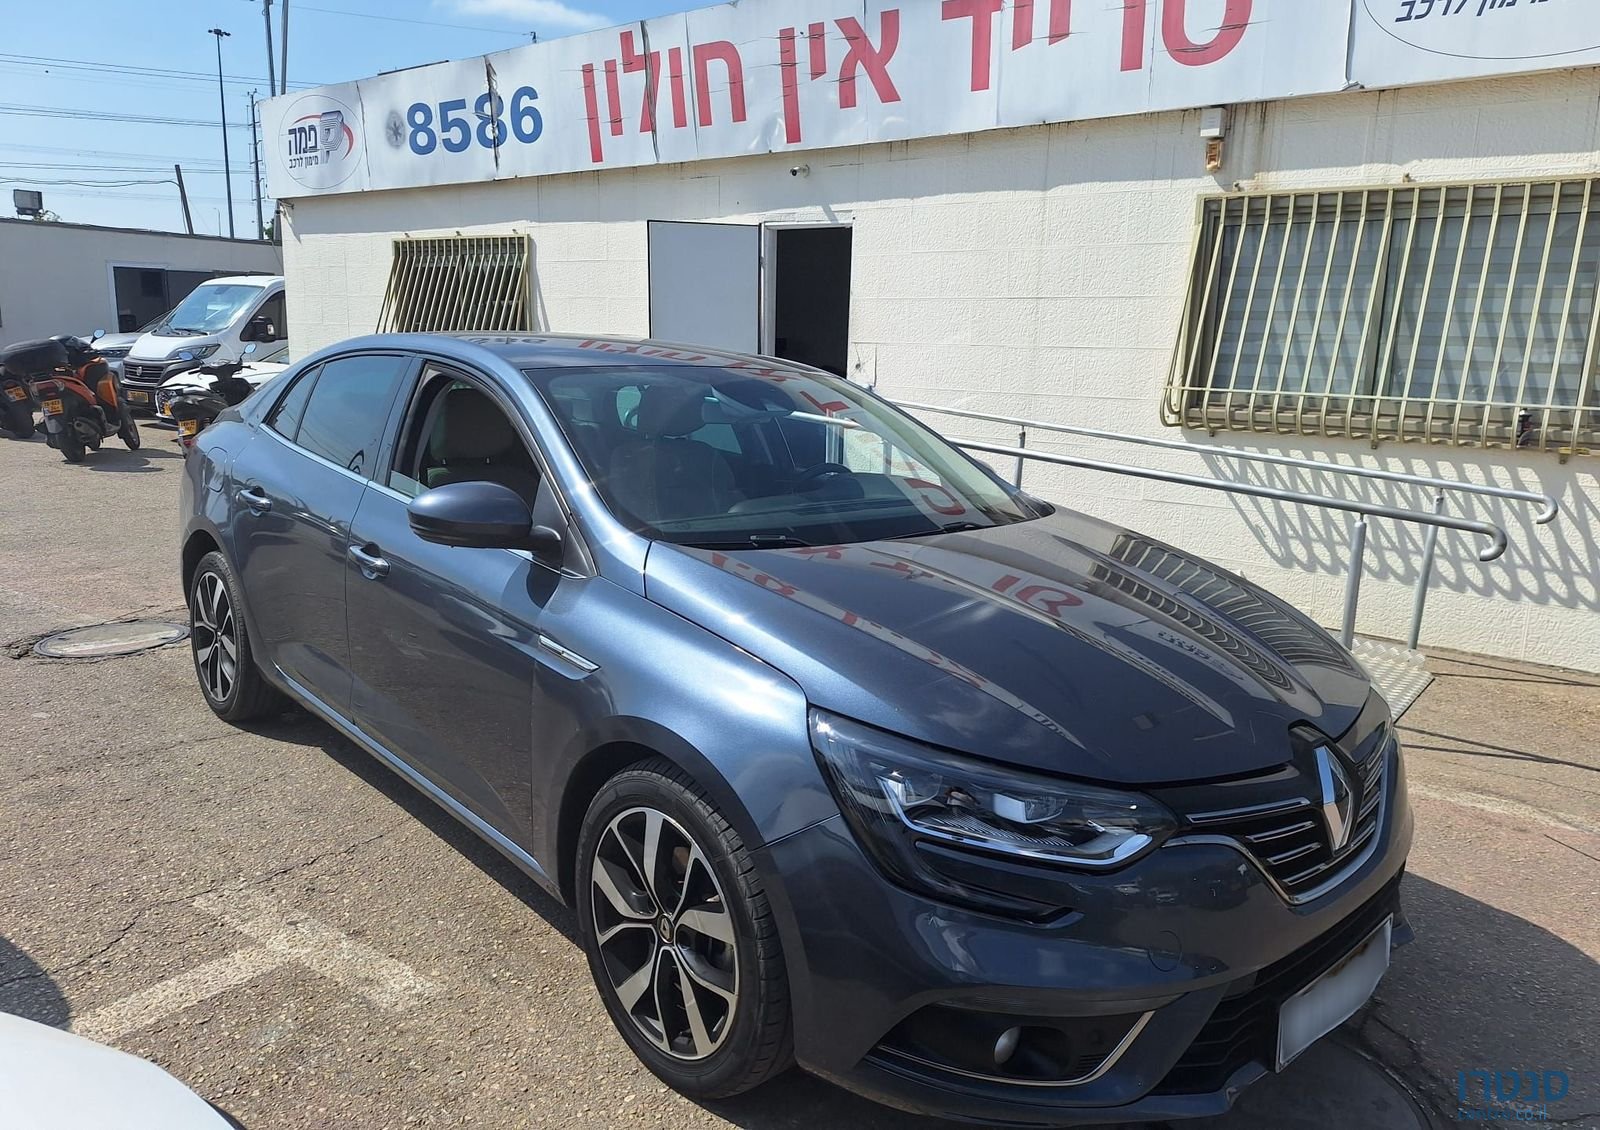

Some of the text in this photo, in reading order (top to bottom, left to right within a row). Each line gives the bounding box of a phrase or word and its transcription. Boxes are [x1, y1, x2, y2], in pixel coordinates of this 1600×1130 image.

[581, 30, 746, 163] חולון
[779, 9, 901, 144] אין
[288, 156, 304, 169] לרכב
